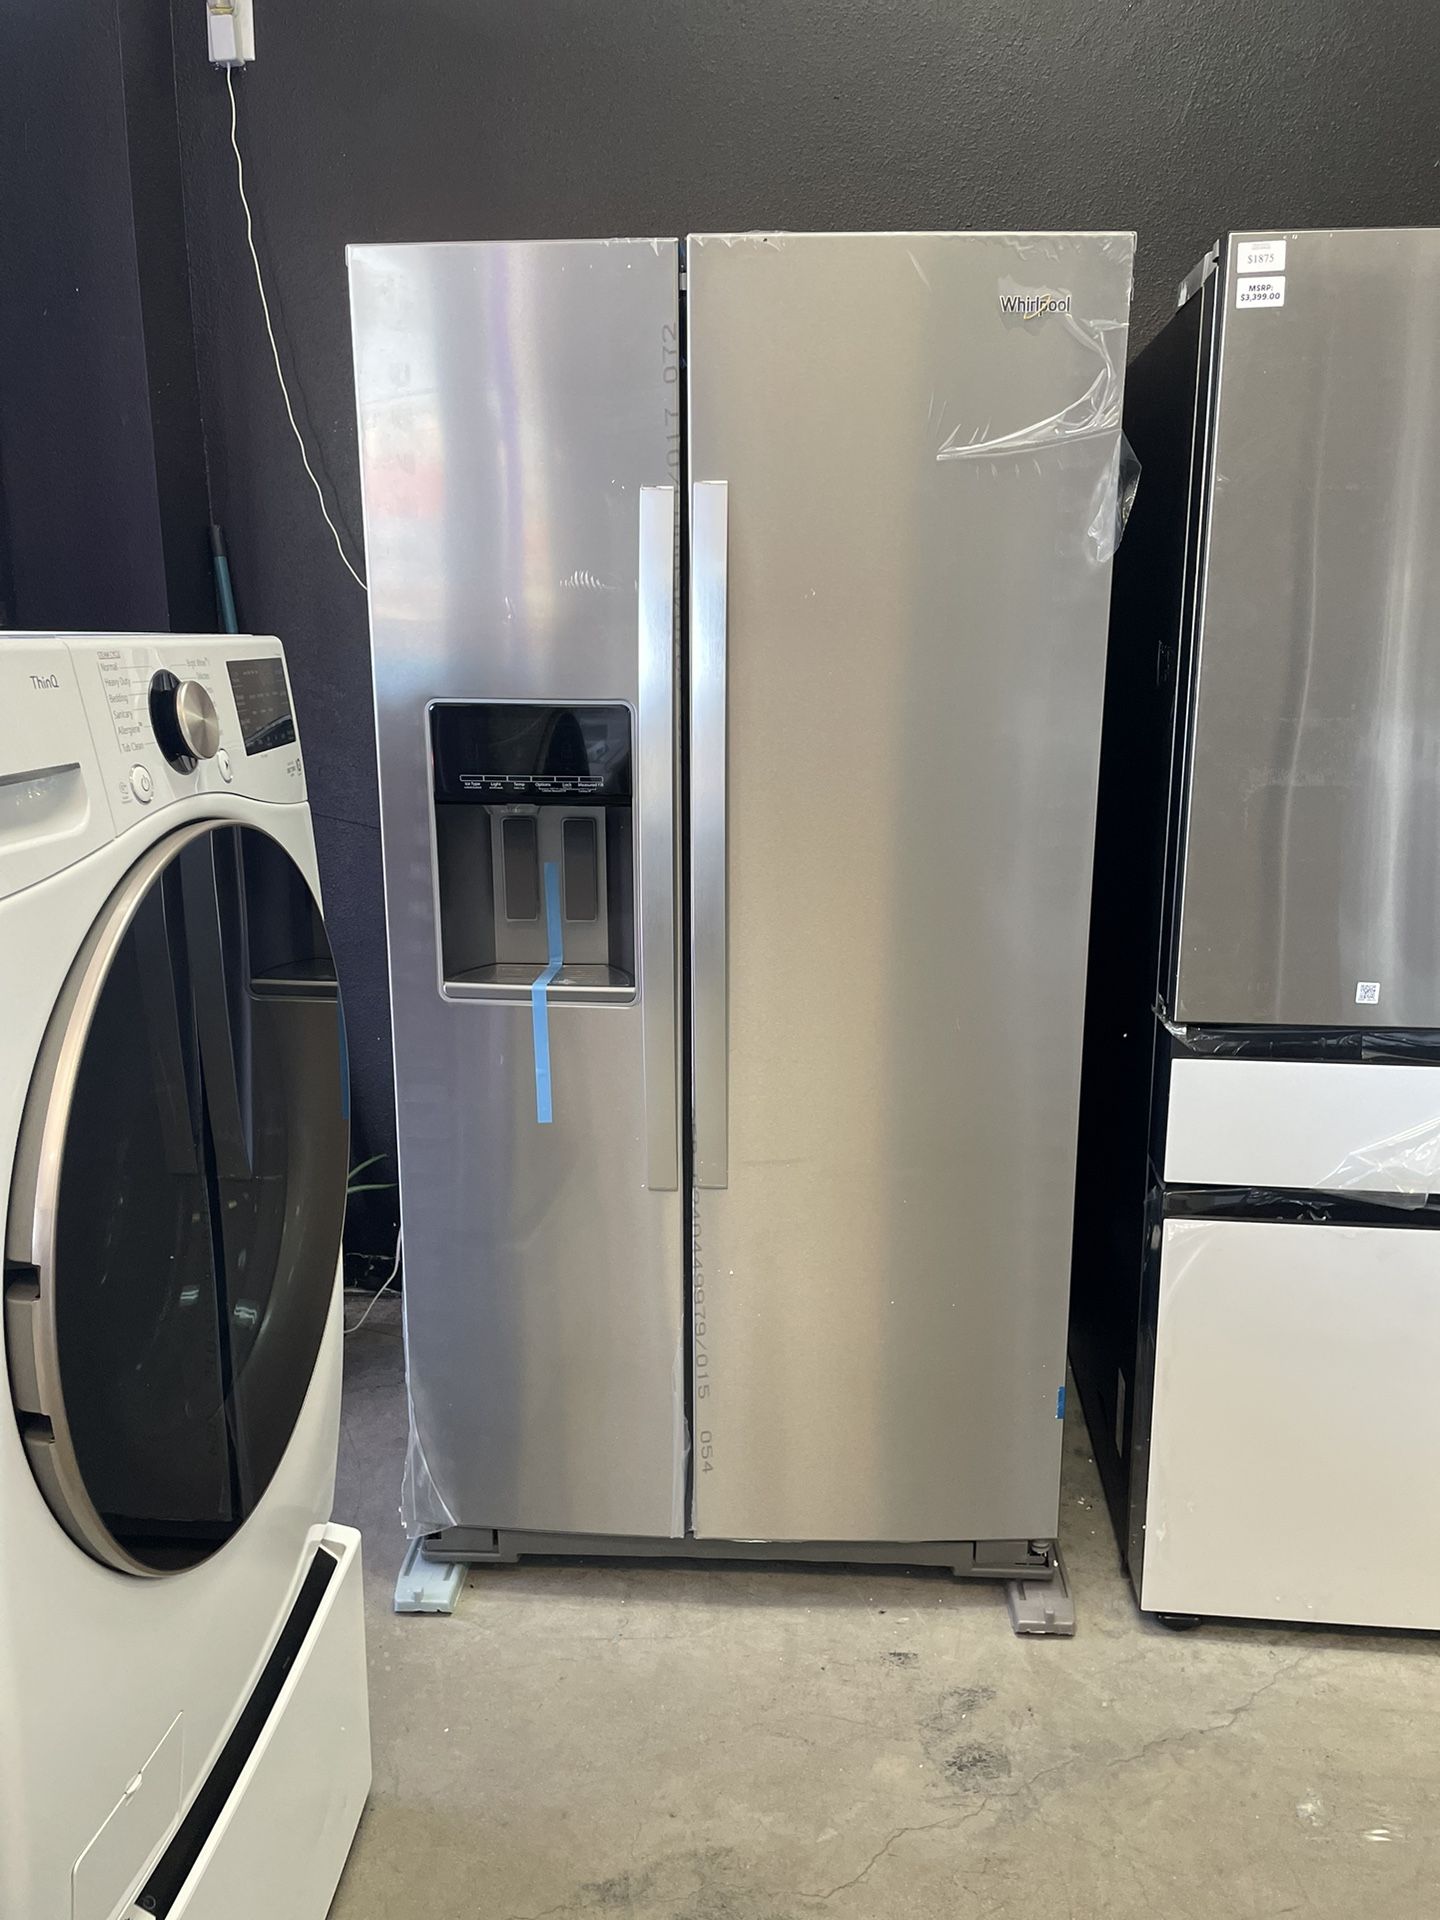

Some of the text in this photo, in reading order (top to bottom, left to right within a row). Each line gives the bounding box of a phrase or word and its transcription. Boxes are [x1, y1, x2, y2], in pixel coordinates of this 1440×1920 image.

[1247, 253, 1275, 264] $1875
[1248, 284, 1274, 292] MSRP:
[1240, 292, 1281, 302] $3,399.00
[999, 294, 1071, 319] Whirlpool
[29, 673, 60, 690] ThinQ
[700, 1430, 714, 1474] 054
